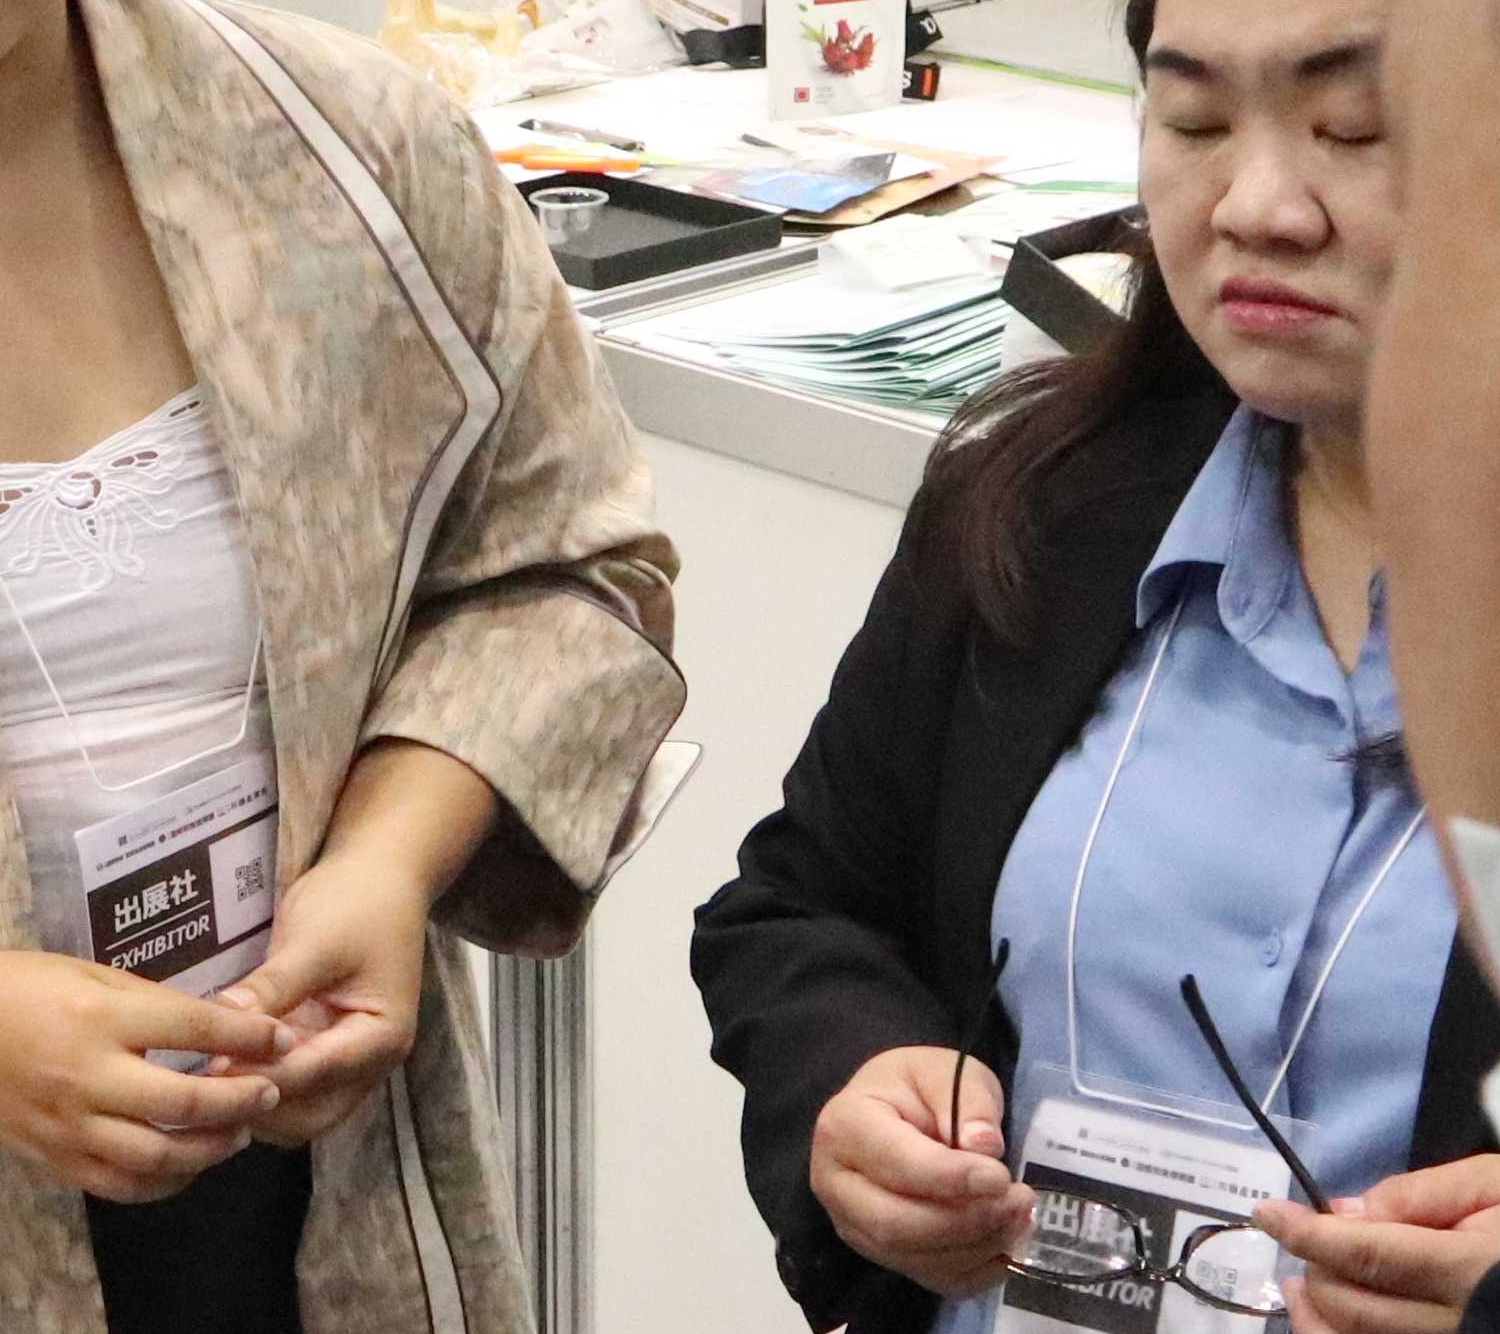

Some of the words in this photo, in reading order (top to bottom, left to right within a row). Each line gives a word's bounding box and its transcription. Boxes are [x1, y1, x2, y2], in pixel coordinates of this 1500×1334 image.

[114, 869, 199, 934] 出展社
[111, 914, 211, 970] EXHIBITOR
